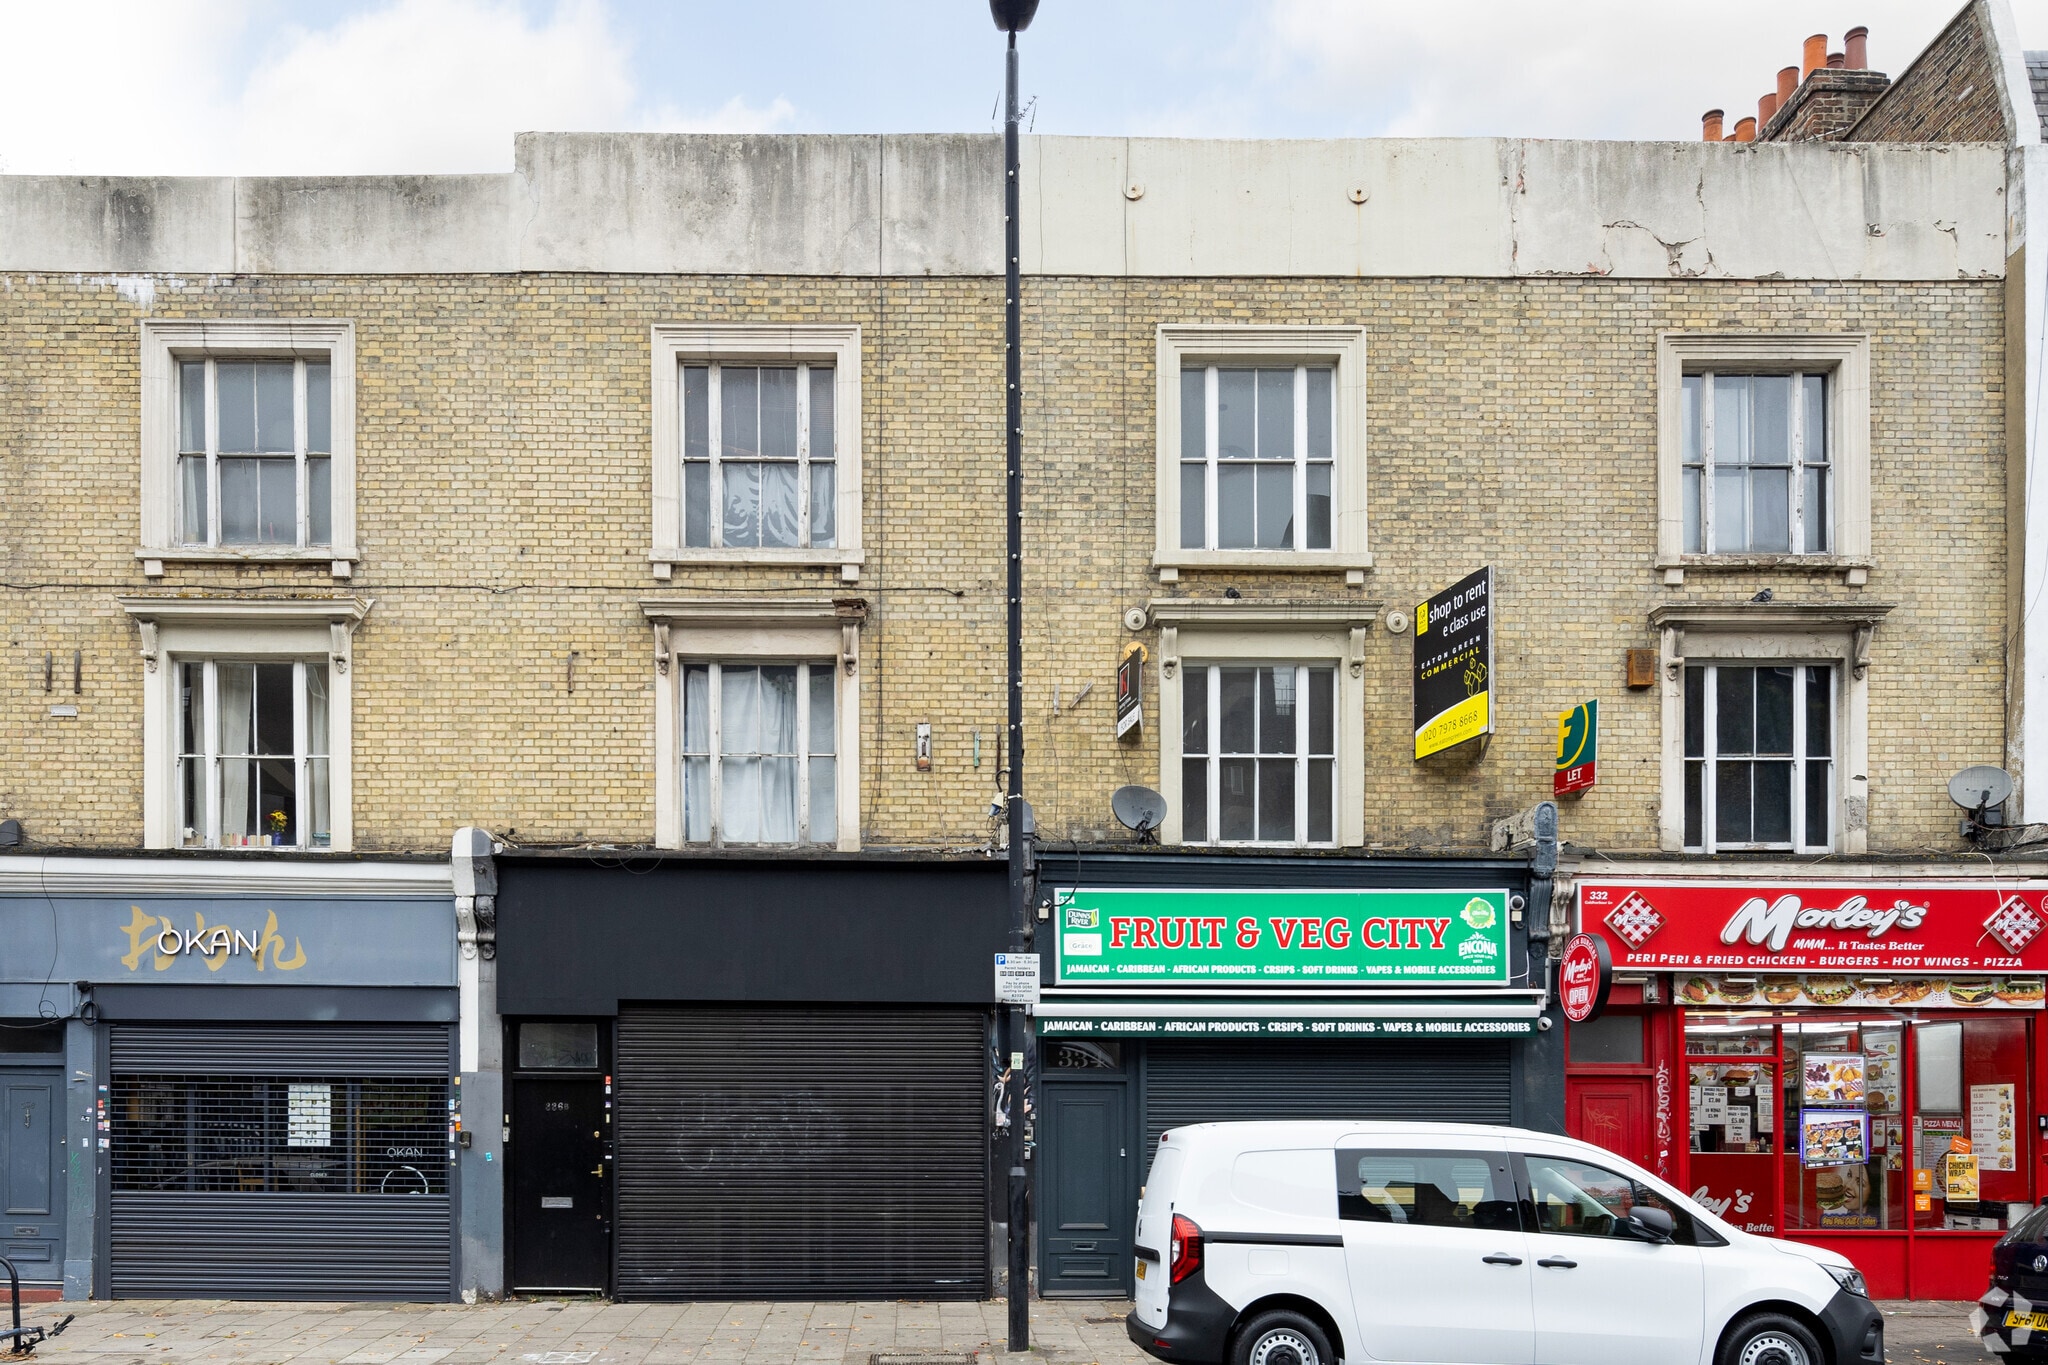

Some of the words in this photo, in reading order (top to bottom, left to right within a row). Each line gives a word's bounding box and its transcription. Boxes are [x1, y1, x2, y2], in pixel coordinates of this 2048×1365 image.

[1429, 601, 1451, 624] shop
[1453, 594, 1463, 610] to
[1465, 580, 1486, 603] rent
[1442, 625, 1448, 637] e
[1449, 614, 1469, 634] class
[1470, 605, 1486, 622] use
[1421, 651, 1448, 669] EATON
[1452, 635, 1481, 654] GREEN
[1421, 646, 1480, 680] COMMERCIAL
[1424, 727, 1436, 742] 020
[1439, 719, 1457, 735] 7978
[1459, 710, 1478, 728] 8668
[1567, 767, 1583, 782] LET
[1590, 891, 1608, 900] 332
[1719, 893, 1929, 952] Morley's
[1110, 917, 1227, 949] FRUIT
[1235, 917, 1262, 949] &
[1270, 917, 1352, 950] VEG
[1362, 917, 1451, 950] CITY
[157, 929, 257, 955] OKAN
[1458, 940, 1497, 956] ENCONA
[1838, 940, 1848, 950] It
[1850, 940, 1887, 950] Tastes
[1888, 940, 1925, 950] Better
[1626, 953, 1656, 963] PERI
[1659, 954, 1689, 964] PERI
[1693, 955, 1703, 965] &
[1706, 955, 1744, 965] FRIED
[1747, 956, 1806, 966] CHICKEN
[1819, 956, 1879, 966] BURGERS
[1892, 957, 1921, 966] HOT
[1924, 957, 1970, 967] WINGS
[1983, 957, 2023, 967] PIZZA
[1066, 964, 1110, 975] JAMAICAN
[1116, 964, 1166, 974] CARIBBEAN
[1172, 965, 1210, 974] AFRICAN
[1211, 965, 1257, 974] PRODUCTS
[1302, 965, 1323, 974] SOFT
[1325, 965, 1358, 974] DRINKS
[1366, 965, 1393, 974] VAPES
[1394, 965, 1402, 974] &
[1403, 965, 1436, 974] MOBILE
[1438, 965, 1496, 974] ACCESSORIES
[1564, 958, 1592, 983] Morley's
[1569, 985, 1589, 1005] OPEN
[1043, 1021, 1093, 1033] JAMAICAN
[1101, 1022, 1157, 1031] CARIBBEAN
[1164, 1022, 1206, 1032] AFRICAN
[1208, 1022, 1260, 1032] PRODUCTS
[1267, 1022, 1304, 1032] CRSIPS
[1311, 1022, 1337, 1032] SOFT
[1338, 1022, 1375, 1032] DRINKS
[1383, 1022, 1414, 1032] VAPES
[1415, 1022, 1424, 1032] &
[1425, 1022, 1463, 1032] MOBILE
[1464, 1022, 1531, 1032] ACCESSORIES
[1941, 1120, 1961, 1128] MENU
[387, 1147, 423, 1157] OKAN
[1948, 1161, 1974, 1170] CHICKEN
[1948, 1169, 1966, 1177] WRAP
